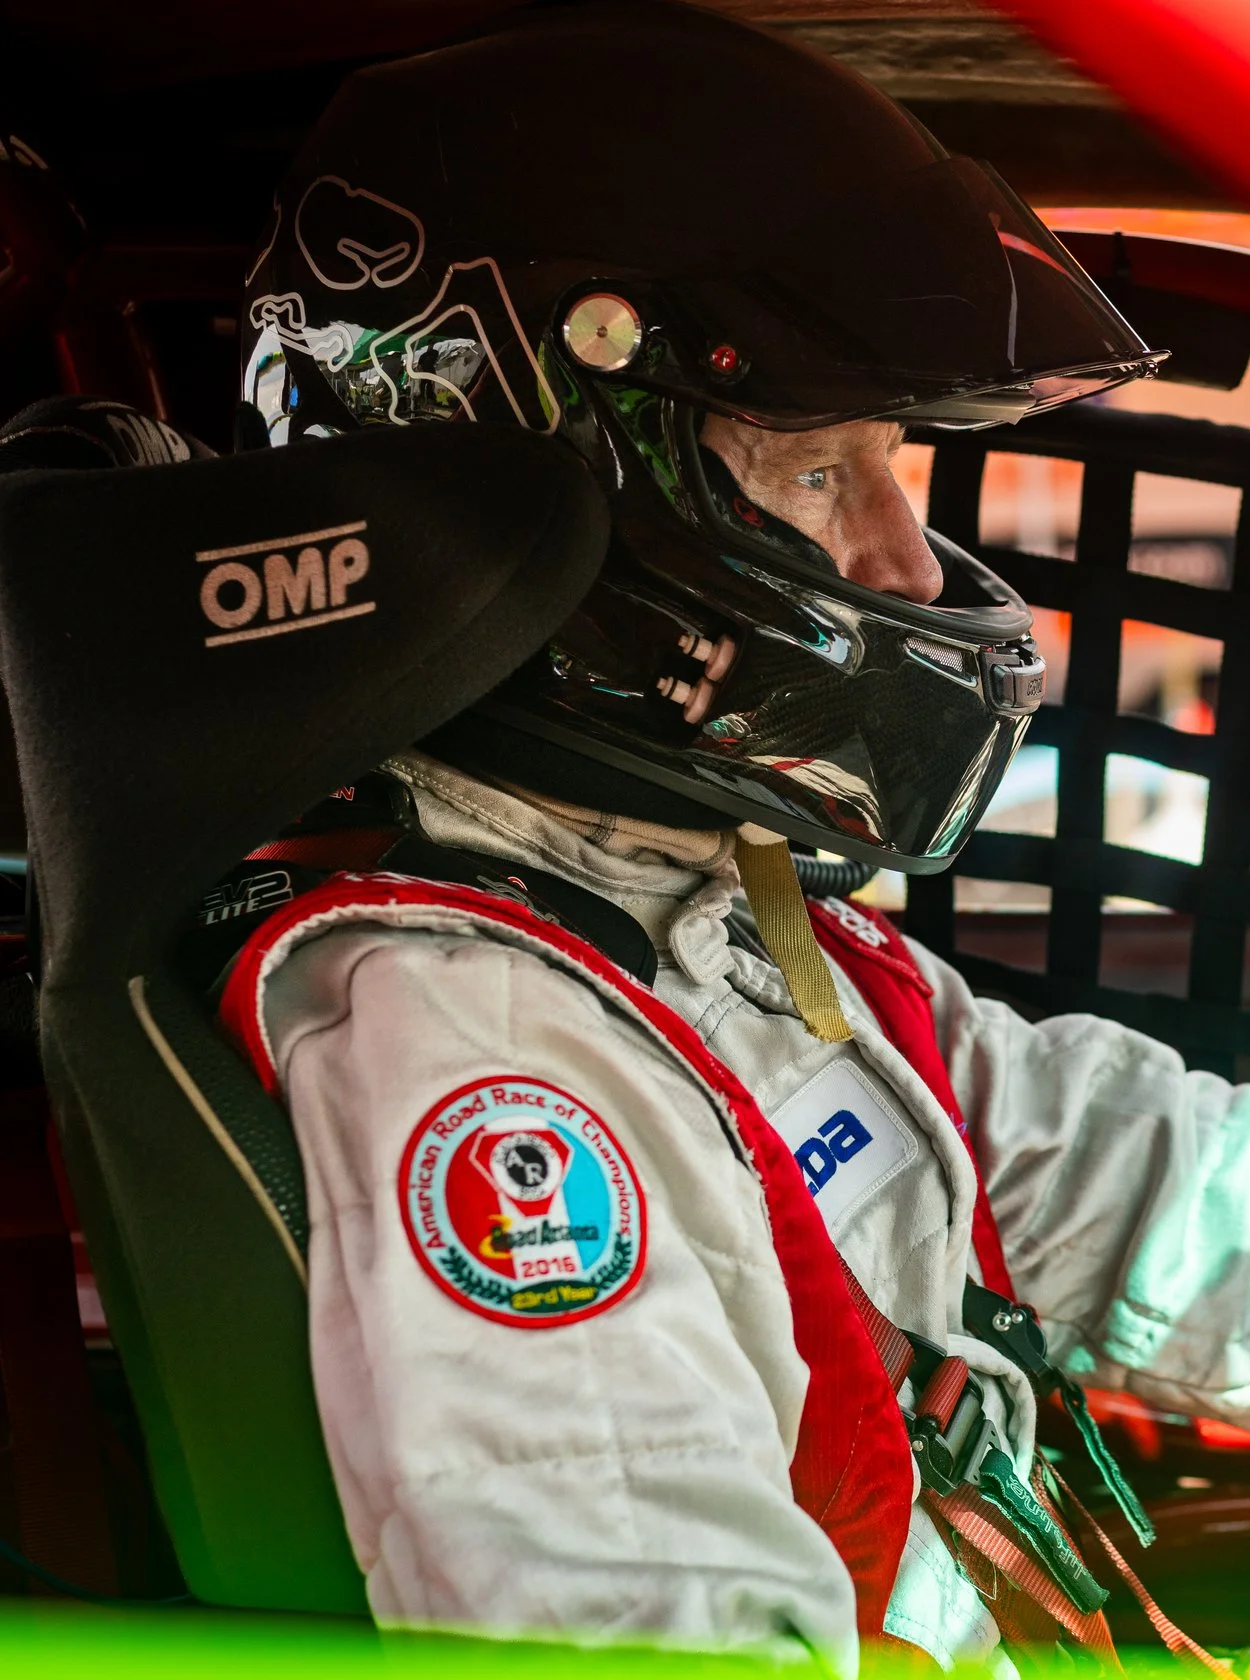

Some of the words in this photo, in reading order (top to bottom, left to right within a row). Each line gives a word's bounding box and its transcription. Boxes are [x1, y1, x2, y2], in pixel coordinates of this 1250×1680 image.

[200, 538, 370, 629] OMP
[206, 900, 260, 925] LITE
[411, 1144, 447, 1249] American
[432, 1095, 487, 1140] Road
[490, 1087, 547, 1108] Race
[553, 1102, 578, 1120] of
[581, 1118, 632, 1236] Champions
[522, 1256, 576, 1278] 2016
